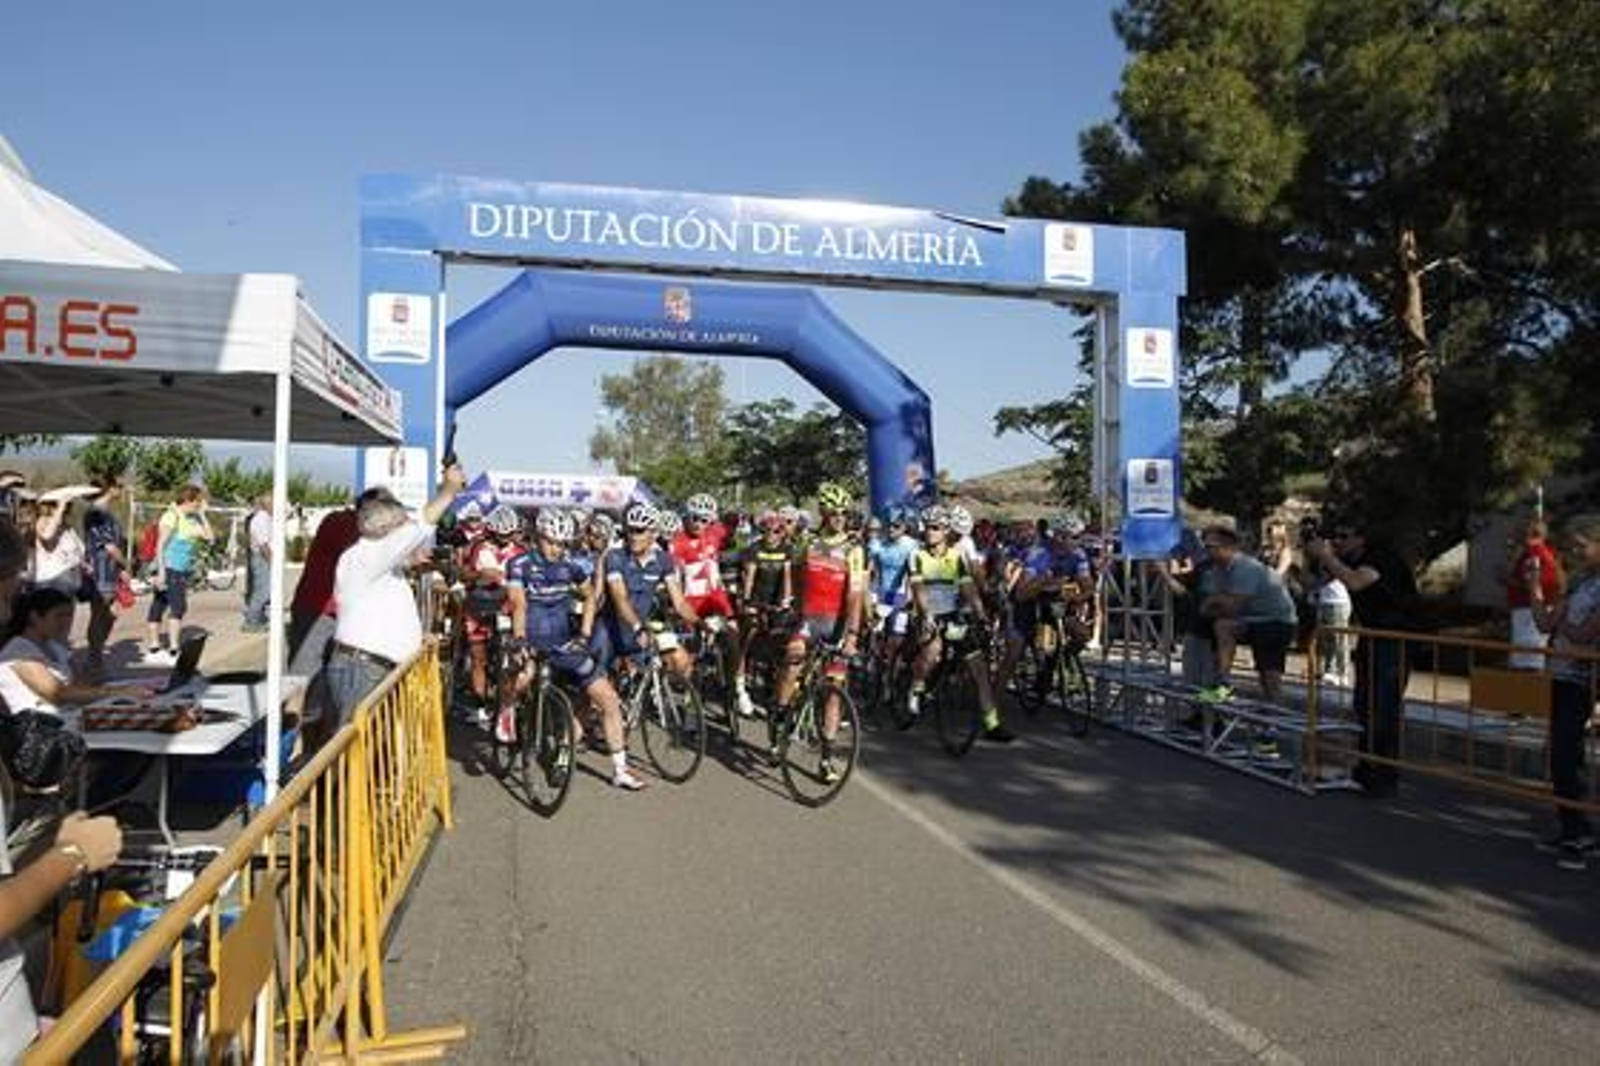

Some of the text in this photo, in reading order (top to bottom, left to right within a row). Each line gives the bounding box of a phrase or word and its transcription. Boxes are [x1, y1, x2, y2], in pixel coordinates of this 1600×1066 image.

[469, 202, 983, 266] DIPUTACIÓN DE ALMERÍA
